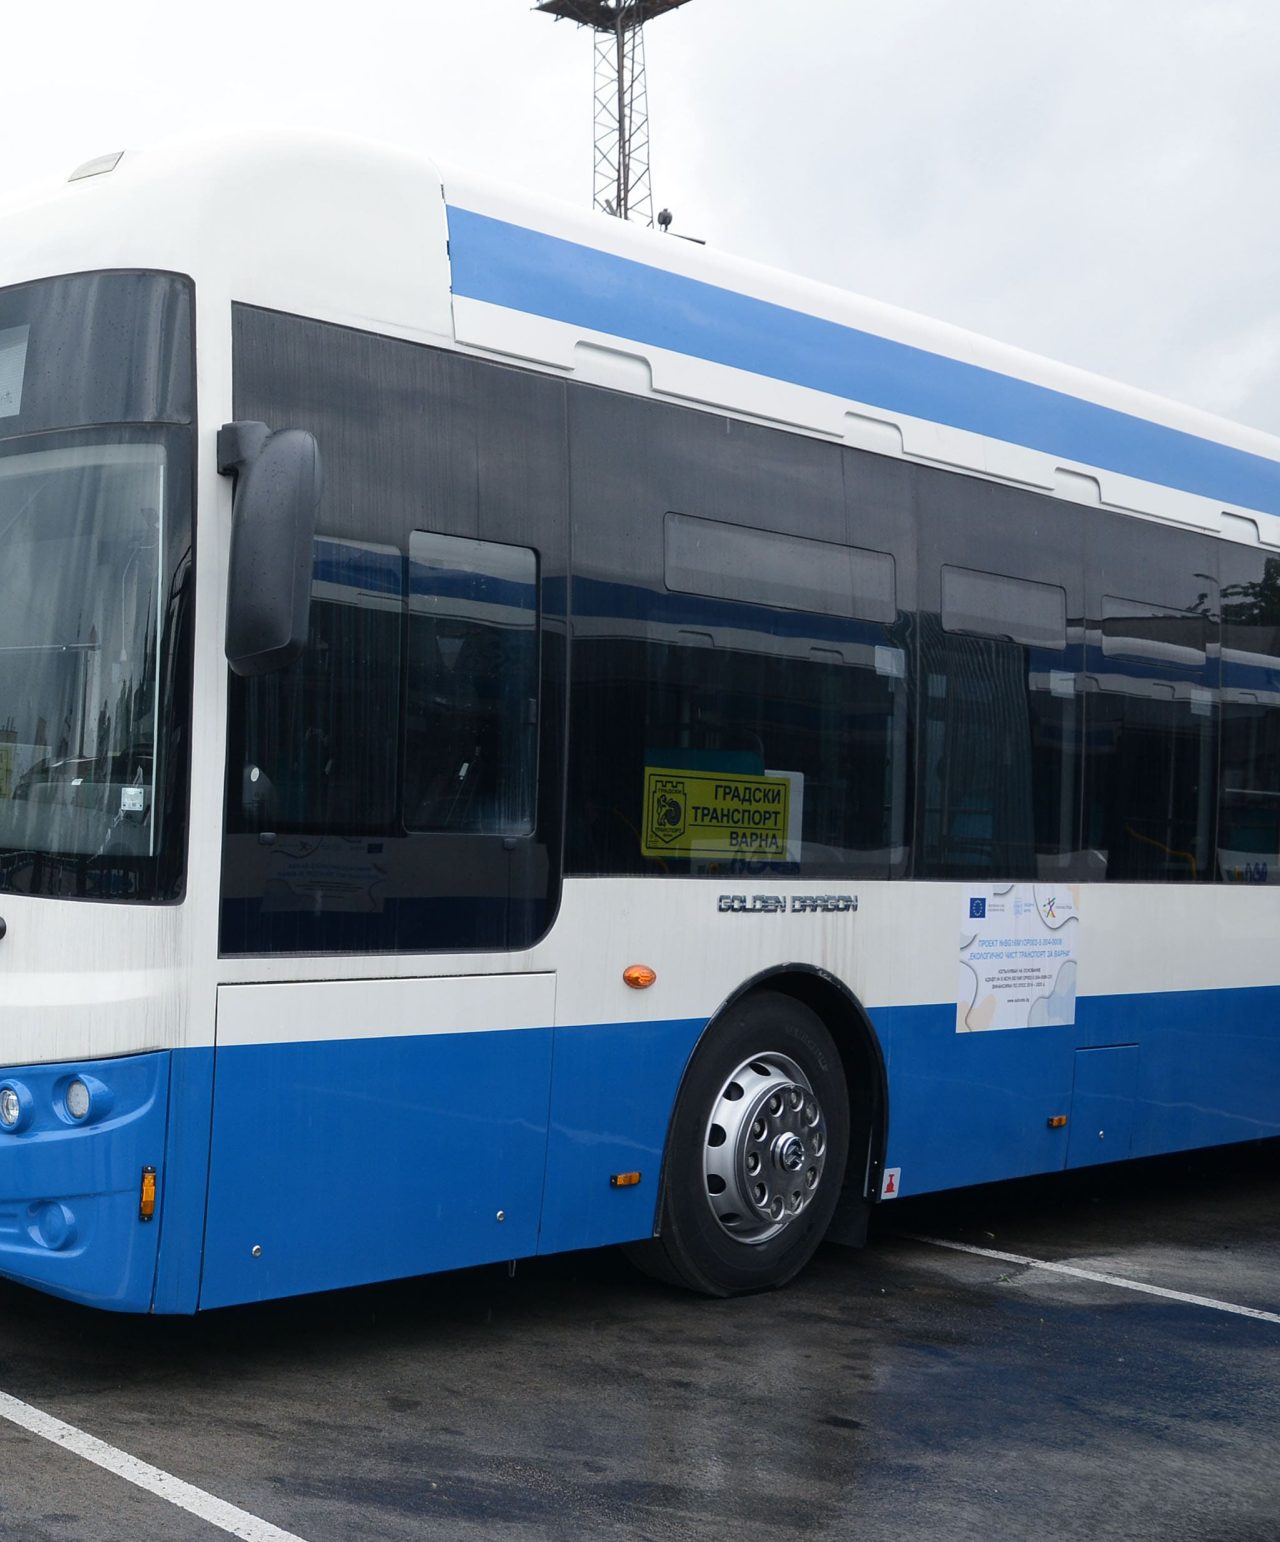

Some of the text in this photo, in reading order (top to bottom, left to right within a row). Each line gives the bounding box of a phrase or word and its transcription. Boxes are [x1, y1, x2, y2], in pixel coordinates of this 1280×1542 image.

[714, 784, 781, 805] ГРАДСКИ
[691, 806, 781, 827] ТРАНСПОРТ
[729, 831, 779, 848] ВАРНА
[718, 895, 858, 913] GOLDEN DRAGON
